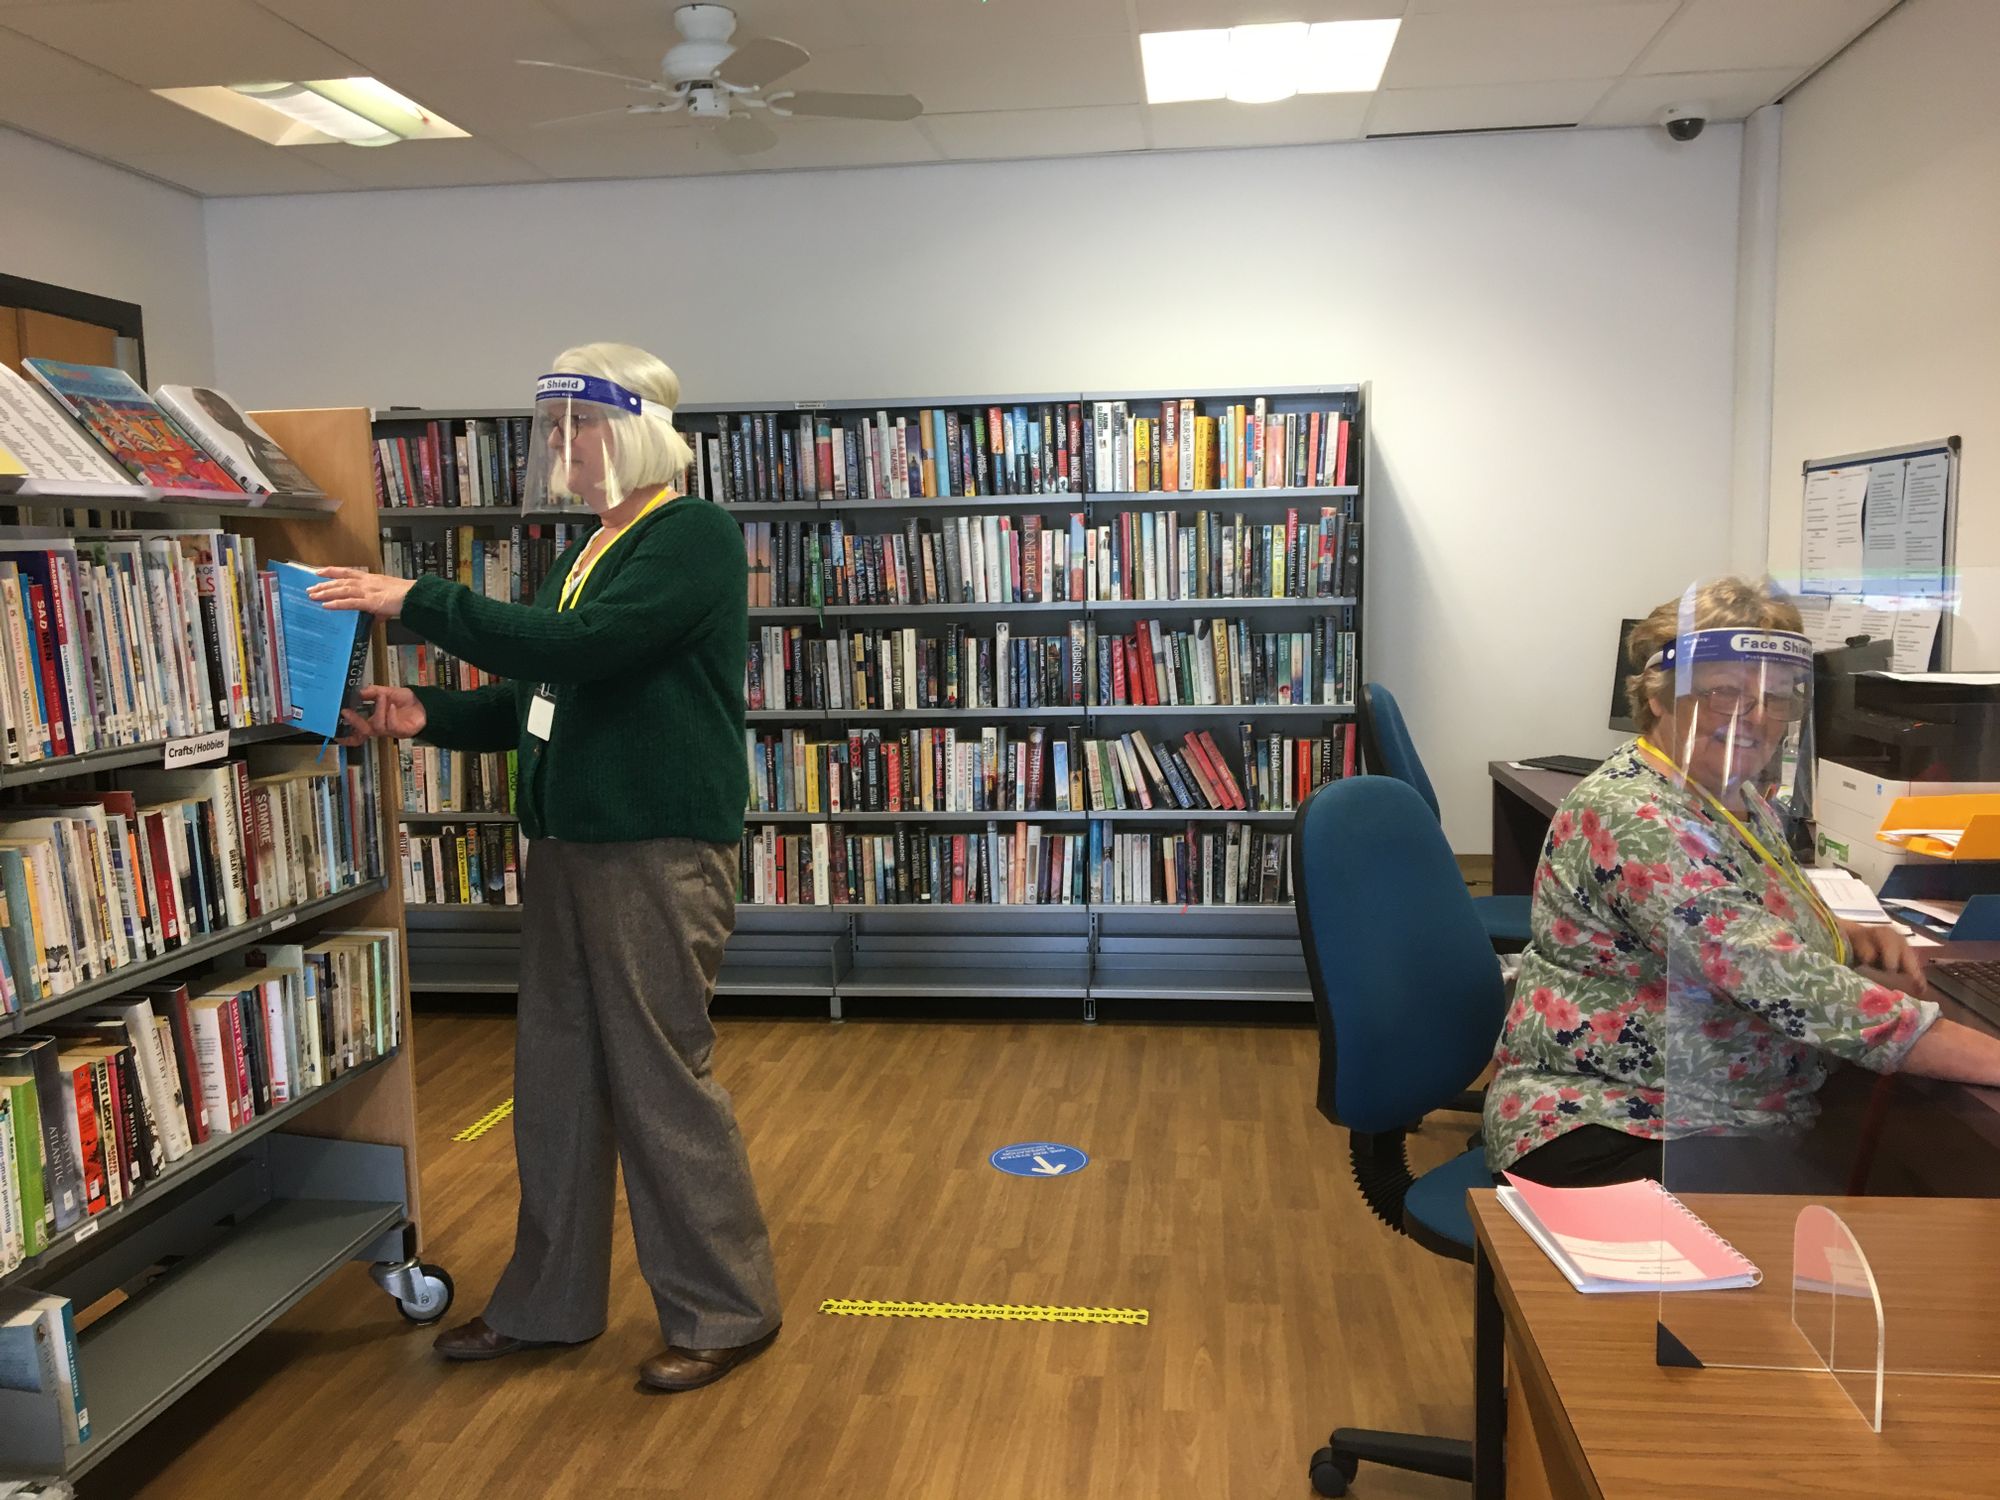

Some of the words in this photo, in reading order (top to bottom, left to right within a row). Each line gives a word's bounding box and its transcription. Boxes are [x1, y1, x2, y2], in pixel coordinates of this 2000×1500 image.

[546, 379, 579, 389] Shield
[1166, 407, 1175, 428] WILBUR
[1152, 426, 1160, 446] WILBUR
[1166, 429, 1175, 447] SMITH
[1023, 524, 1036, 577] LIONHEART
[50, 556, 62, 596] READER'S
[823, 559, 832, 580] Blind
[54, 600, 63, 627] DIGEST
[37, 600, 47, 629] SAD
[42, 632, 52, 661] MEN
[1740, 637, 1777, 650] Face
[348, 642, 363, 687] FREUD
[1072, 640, 1082, 684] ROBINSON
[893, 677, 902, 694] COVE
[168, 739, 225, 759] Crafts/Hobbies
[903, 746, 911, 769] HARRY
[509, 770, 517, 790] YOU
[1029, 749, 1041, 787] EMPIRE
[903, 770, 912, 793] POTTER
[223, 785, 234, 836] PAXMAN
[256, 794, 272, 846] SOMME
[400, 831, 409, 858] MOTIVE
[229, 849, 237, 872] GREAT
[231, 1003, 241, 1035] SKINT
[235, 1037, 246, 1077] ESTATE
[97, 1062, 108, 1097] FIRST
[104, 1098, 114, 1132] LIGHT
[126, 1093, 134, 1109] GUY
[128, 1112, 139, 1148] WALTERS
[48, 1126, 63, 1184] ATLANTIC
[945, 1308, 1004, 1316] DISTANCE
[1088, 1312, 1134, 1320] PLEASE
